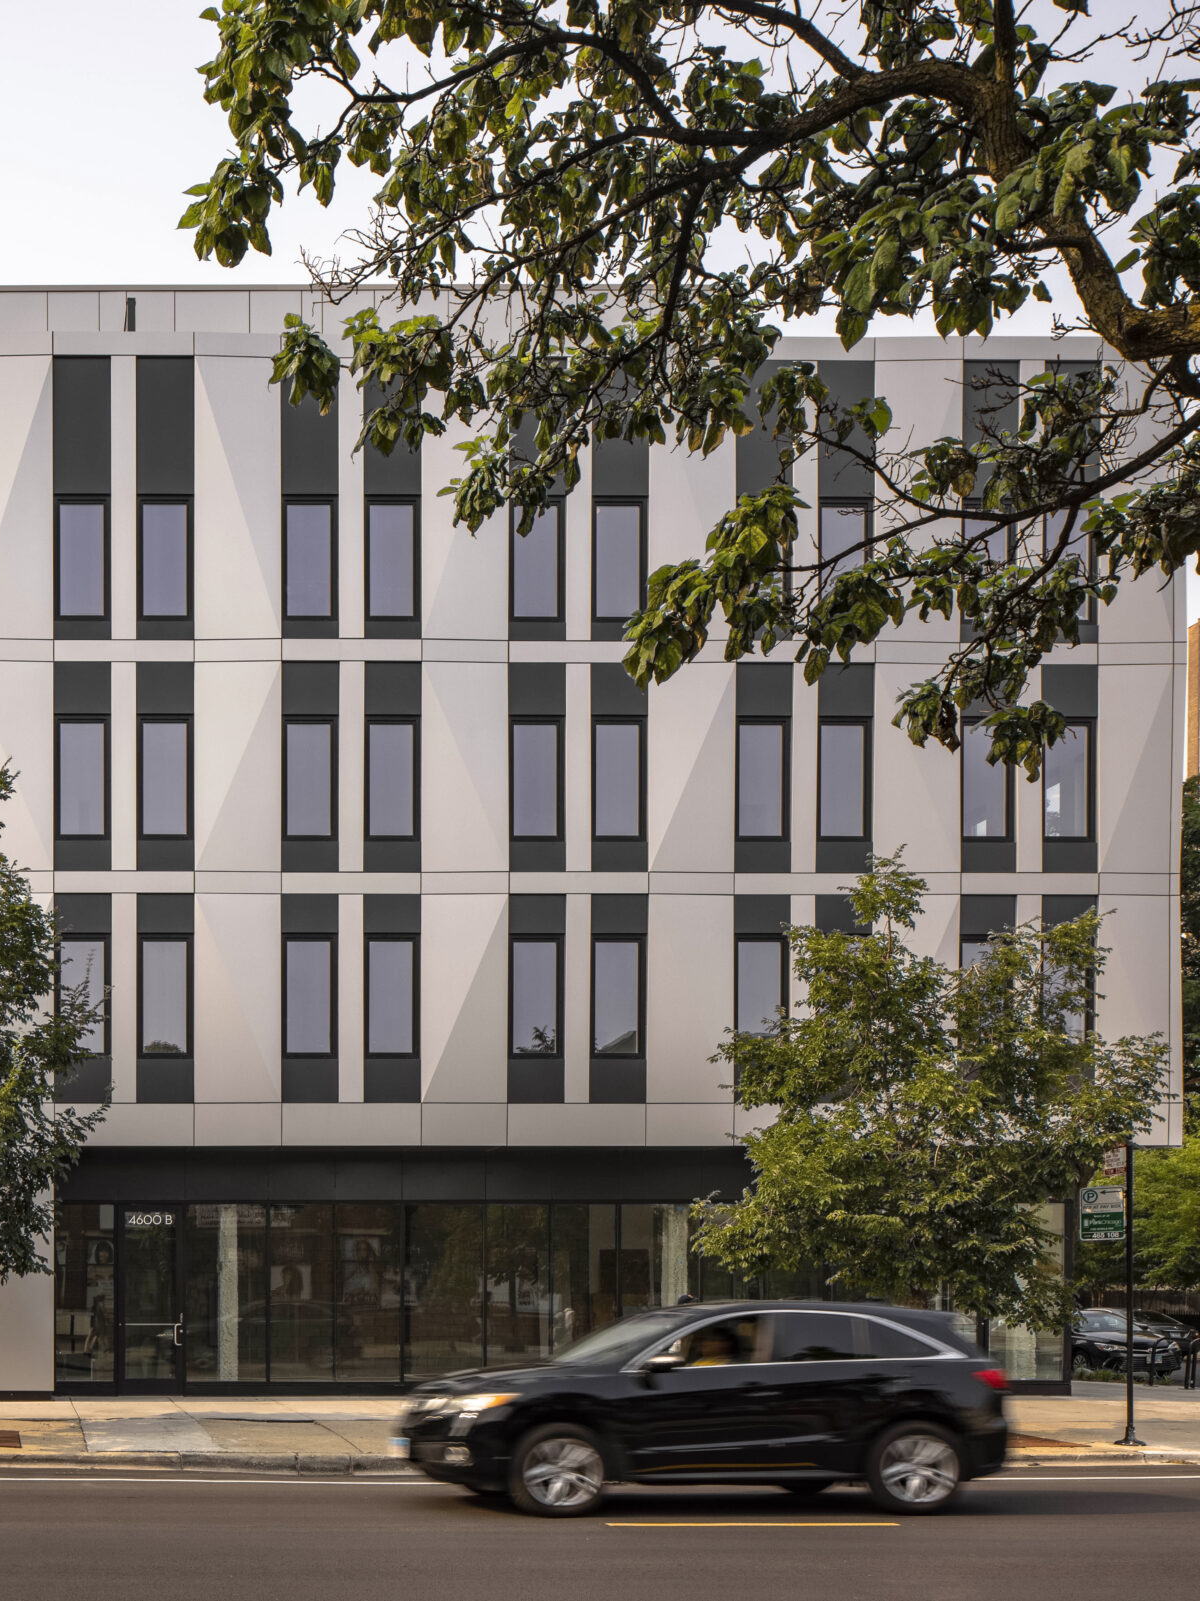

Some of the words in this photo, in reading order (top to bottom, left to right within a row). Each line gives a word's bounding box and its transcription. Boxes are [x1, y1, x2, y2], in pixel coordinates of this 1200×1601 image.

[1087, 1193, 1095, 1201] P
[129, 1214, 162, 1225] 4600
[165, 1214, 173, 1225] B
